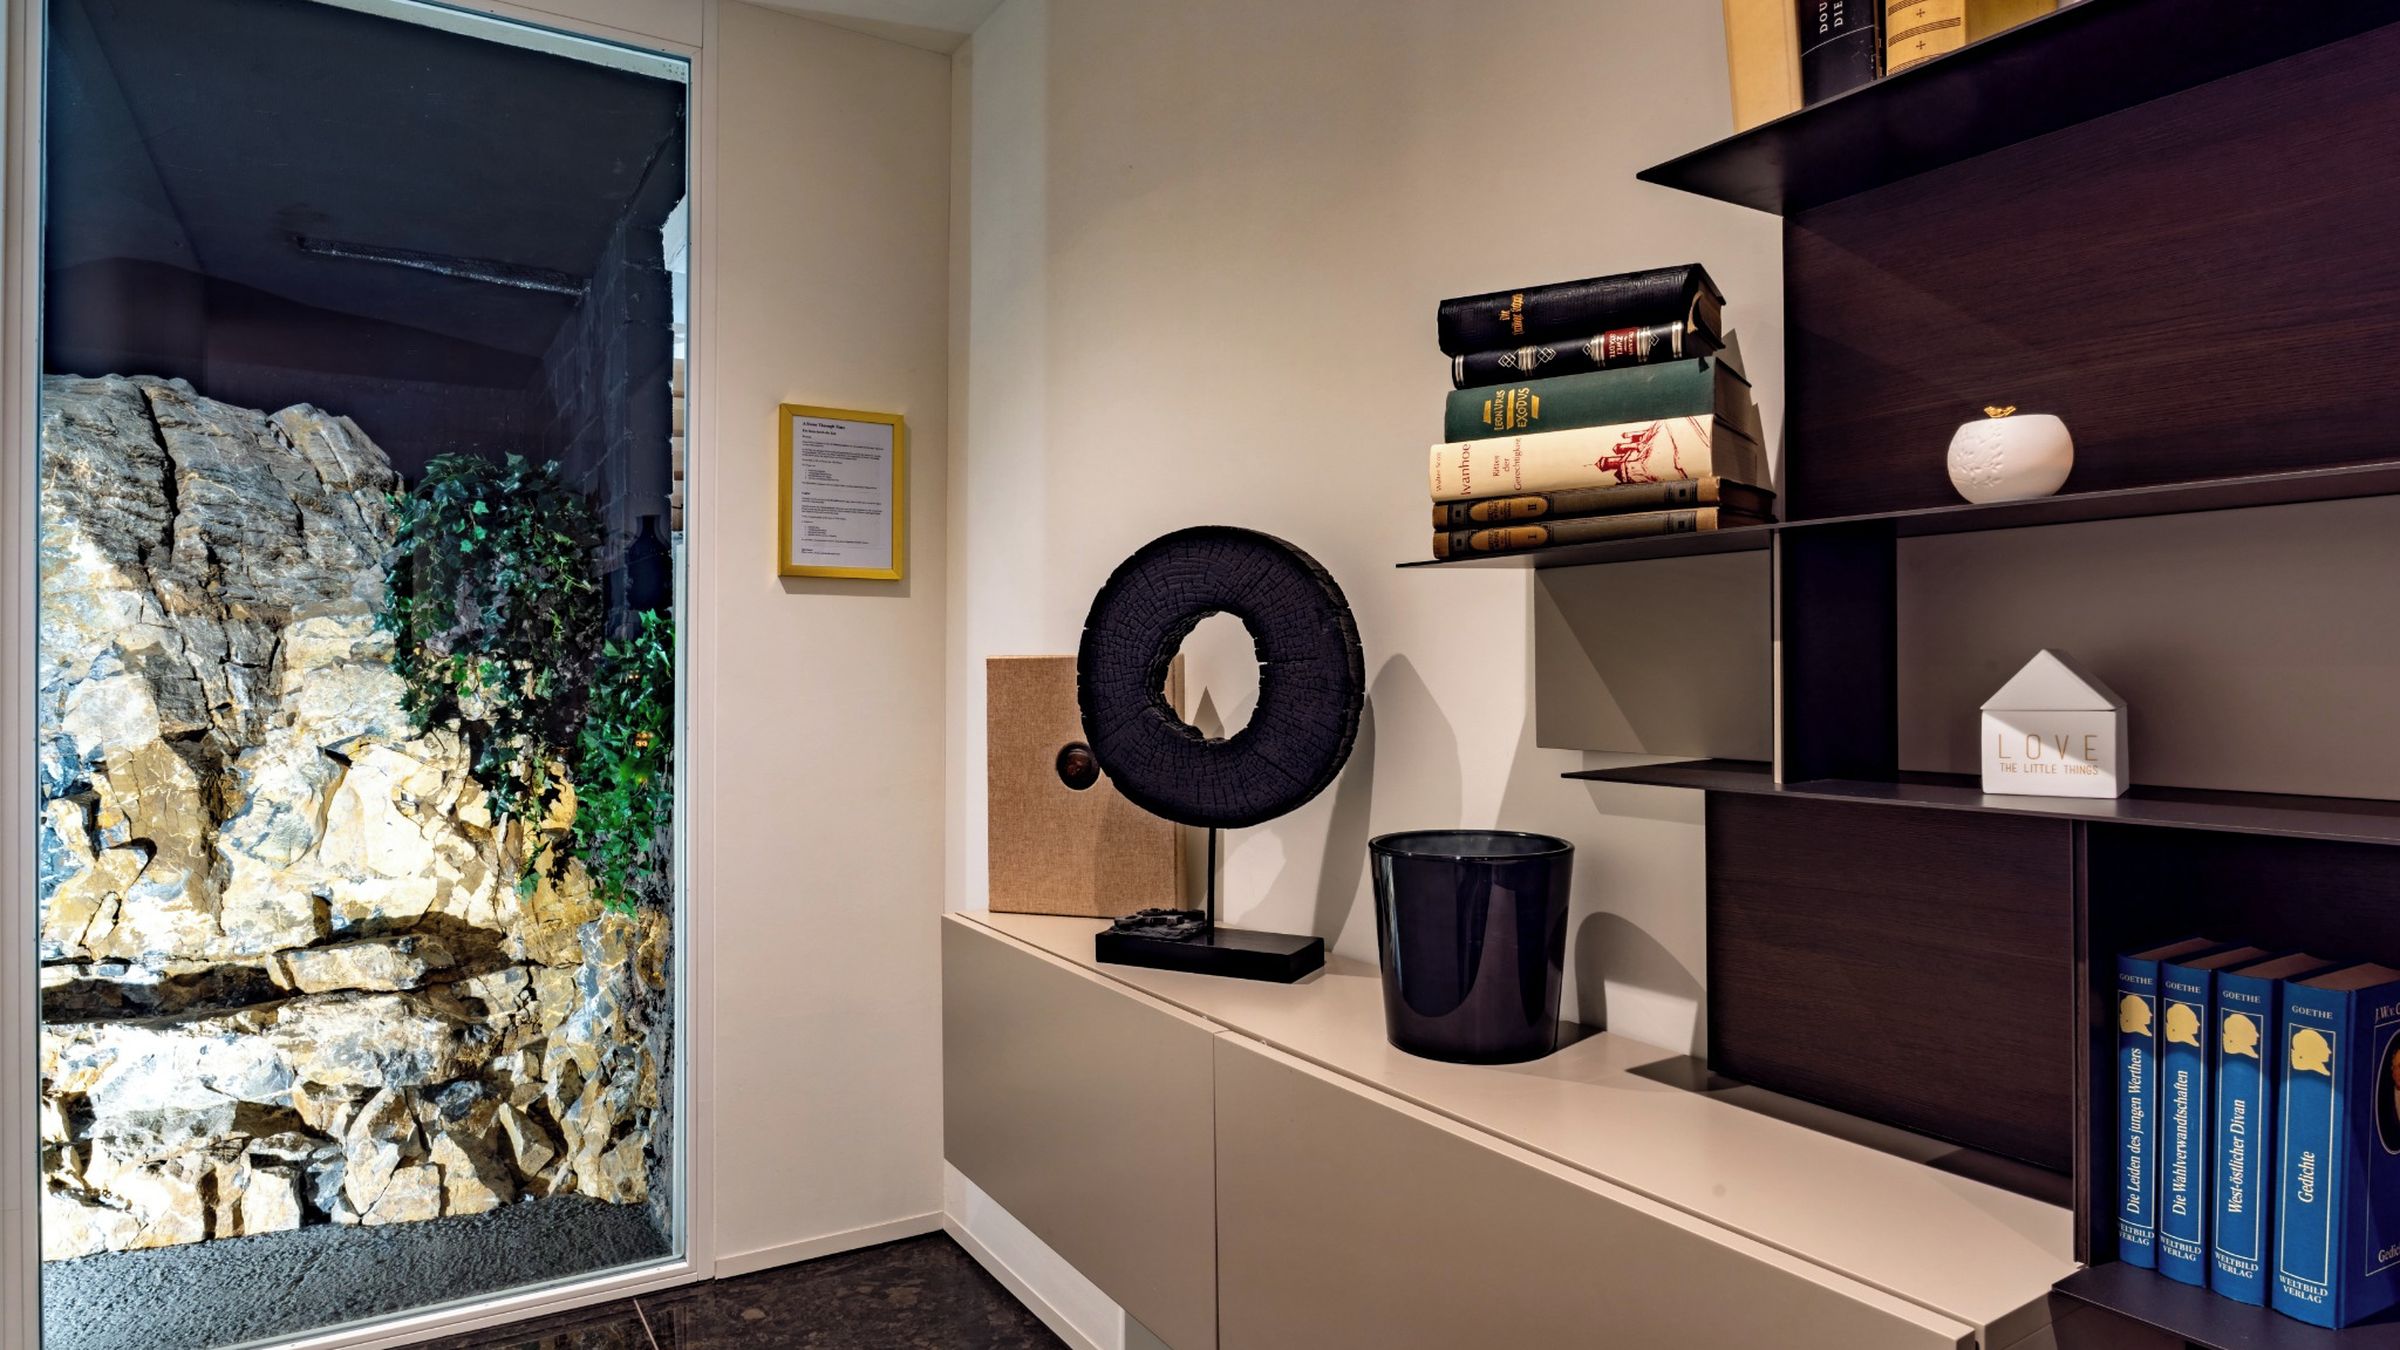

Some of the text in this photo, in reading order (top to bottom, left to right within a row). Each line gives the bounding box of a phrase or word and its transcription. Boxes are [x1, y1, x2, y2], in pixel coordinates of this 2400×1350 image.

[1833, 0, 1843, 27] DIE
[1494, 389, 1506, 431] LEON URIS
[1515, 387, 1530, 428] EXODUS
[1458, 443, 1472, 496] Ivanhoe
[1492, 456, 1500, 477] Ritter
[1998, 734, 2098, 761] LOVE
[2000, 762, 2099, 775] THE LITTLE THINGS
[2120, 973, 2153, 985] GOETHE
[2165, 980, 2201, 994] GOETHE
[2222, 990, 2261, 1004] GOETHE
[2291, 1005, 2334, 1019] GOETHE
[2126, 1048, 2144, 1214] Die Leiden des jungen Werthers
[2172, 1070, 2188, 1216] Die Wahlverwandtschaften
[2228, 1099, 2245, 1213] West-östlicher Divan
[2297, 1151, 2315, 1203] Gedichte
[2160, 1236, 2202, 1255] WELTBILD
[2163, 1245, 2196, 1262] VERLAG
[2215, 1251, 2259, 1272] WELTBILD
[2217, 1261, 2253, 1279] VERLAG
[2280, 1275, 2328, 1297] WELTBILD
[2283, 1285, 2322, 1304] VERLAG
